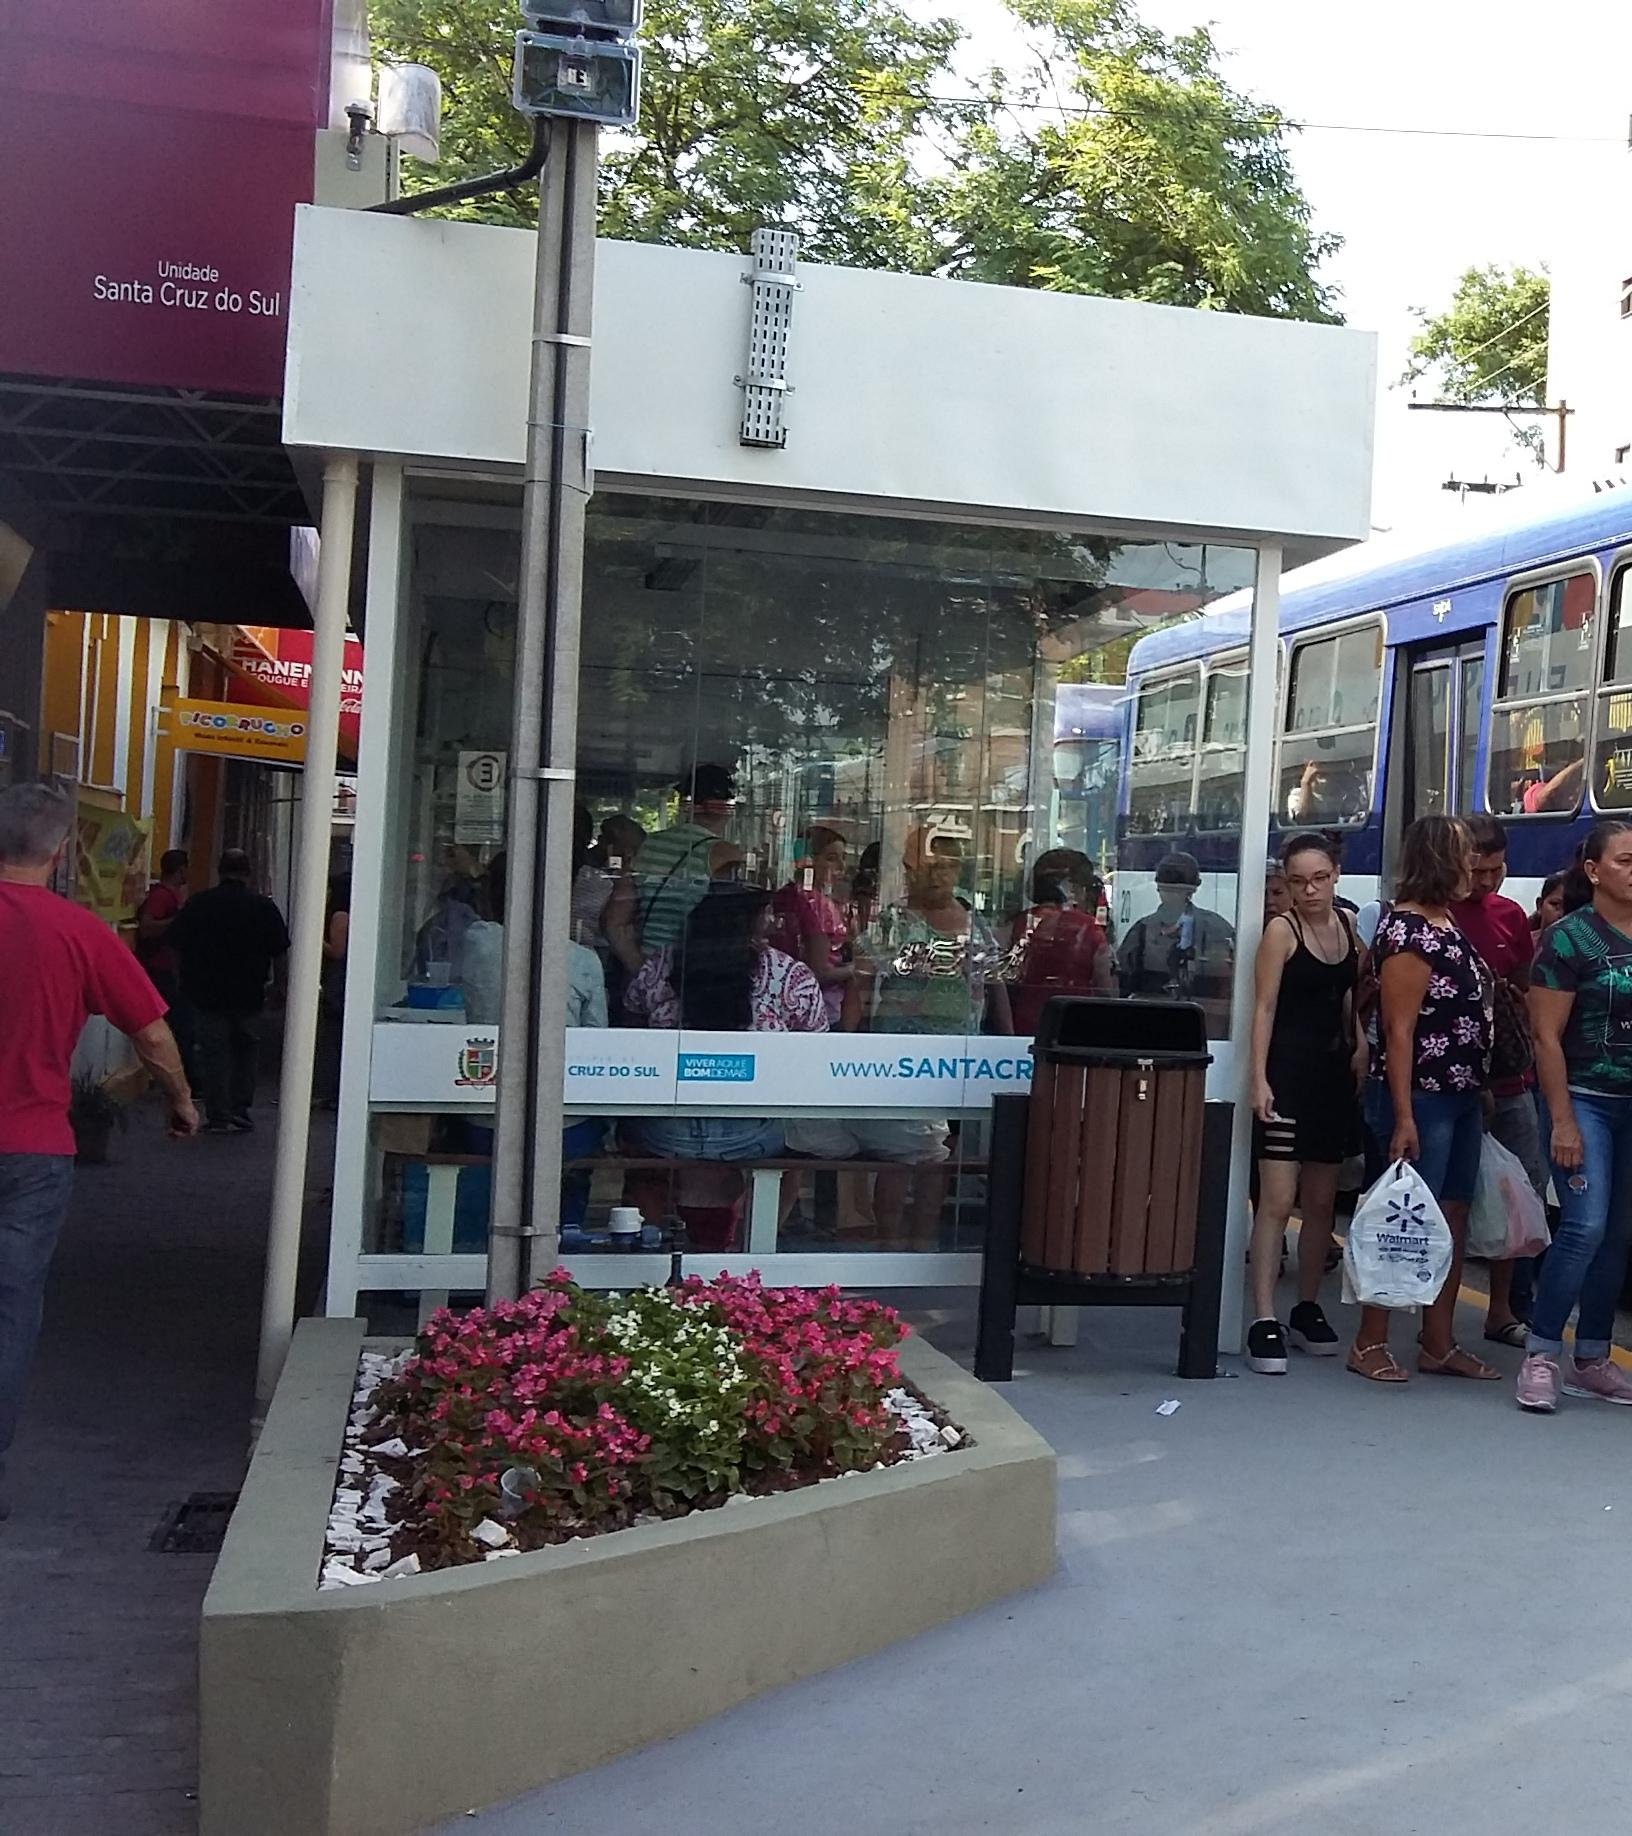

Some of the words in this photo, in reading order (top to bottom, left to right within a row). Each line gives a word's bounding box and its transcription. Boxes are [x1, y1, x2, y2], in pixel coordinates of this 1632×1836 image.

[158, 260, 219, 282] Unidade
[94, 275, 153, 304] Santa
[160, 282, 209, 309] Cruz
[215, 287, 242, 313] do
[249, 290, 280, 316] Sul
[686, 1059, 716, 1067] VIVER
[568, 1065, 604, 1076] CRUZ
[609, 1066, 630, 1077] DO
[634, 1066, 660, 1077] SUL
[684, 1068, 711, 1077] BOM
[1376, 1233, 1429, 1246] Walmart
